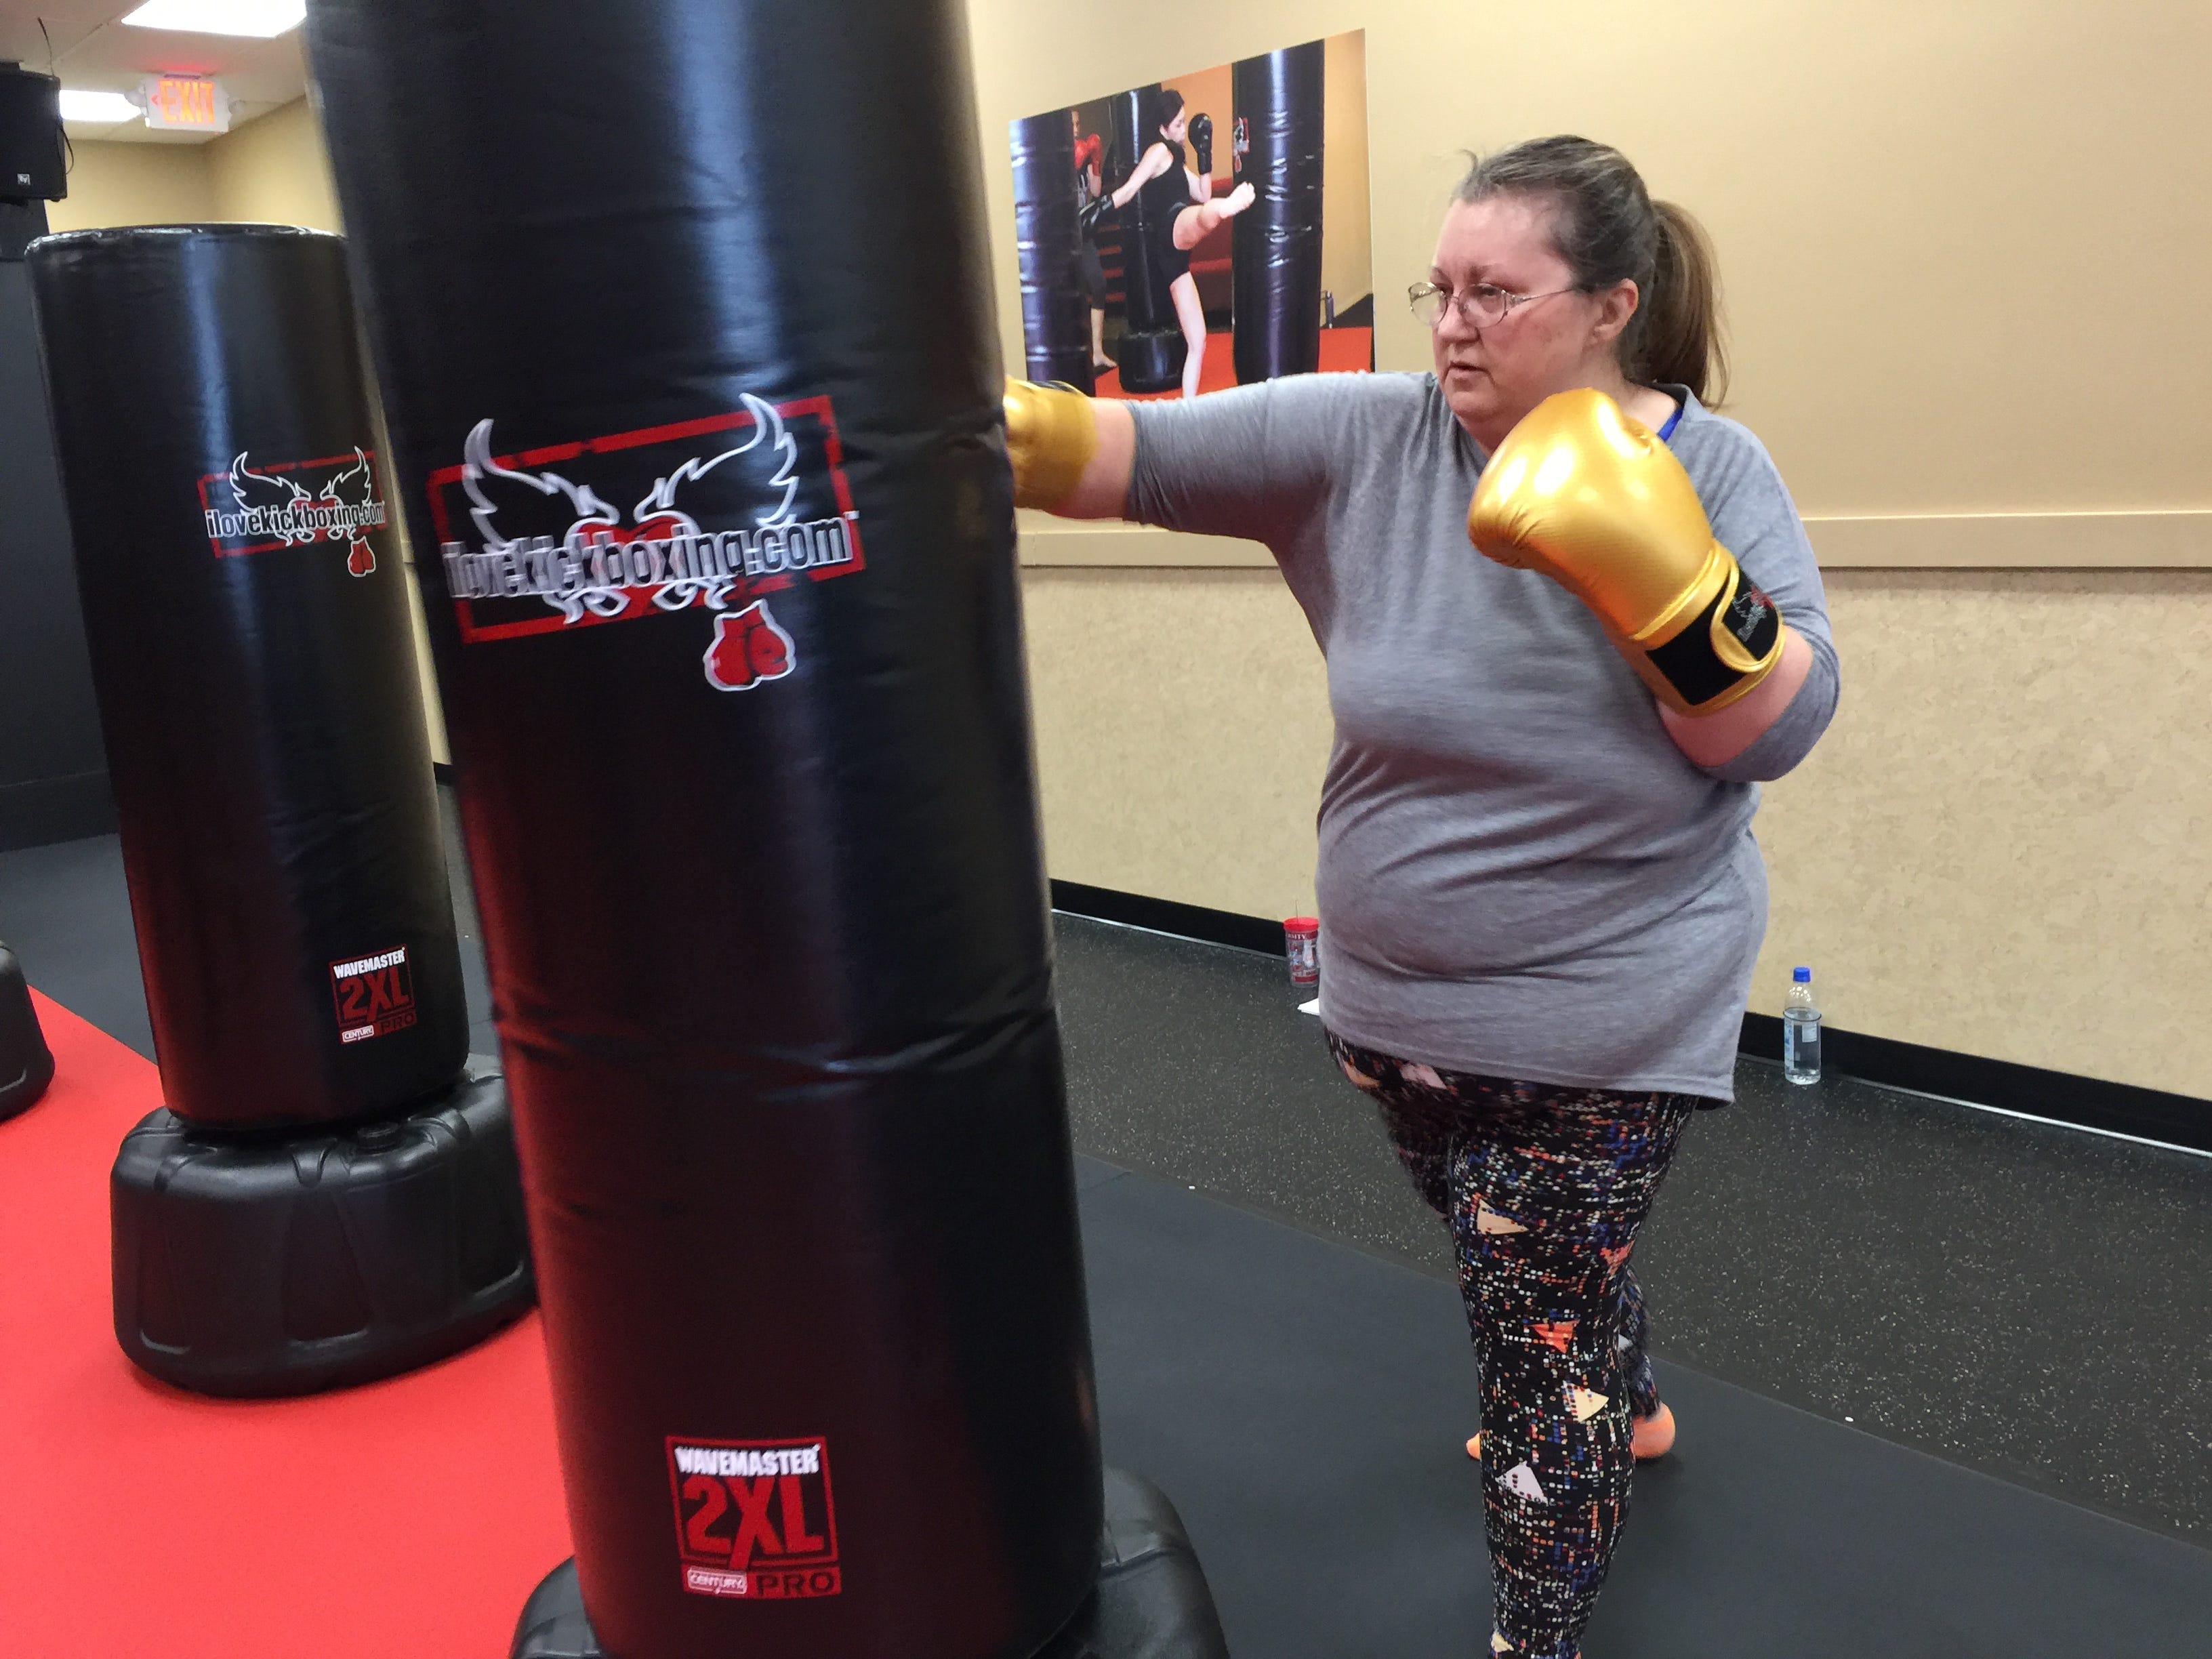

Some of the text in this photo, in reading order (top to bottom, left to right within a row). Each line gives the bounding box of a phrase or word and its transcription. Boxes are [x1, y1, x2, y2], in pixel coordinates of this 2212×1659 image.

[158, 79, 215, 125] EXIT
[205, 500, 386, 539] ilovekickboxing.com
[333, 949, 406, 979] WAVEMASTER
[340, 966, 409, 1023] 2XL
[381, 1012, 415, 1033] PRO
[674, 1446, 819, 1477] WAVEMASTER
[682, 1472, 825, 1569] 2XL
[756, 1572, 834, 1595] PRO
